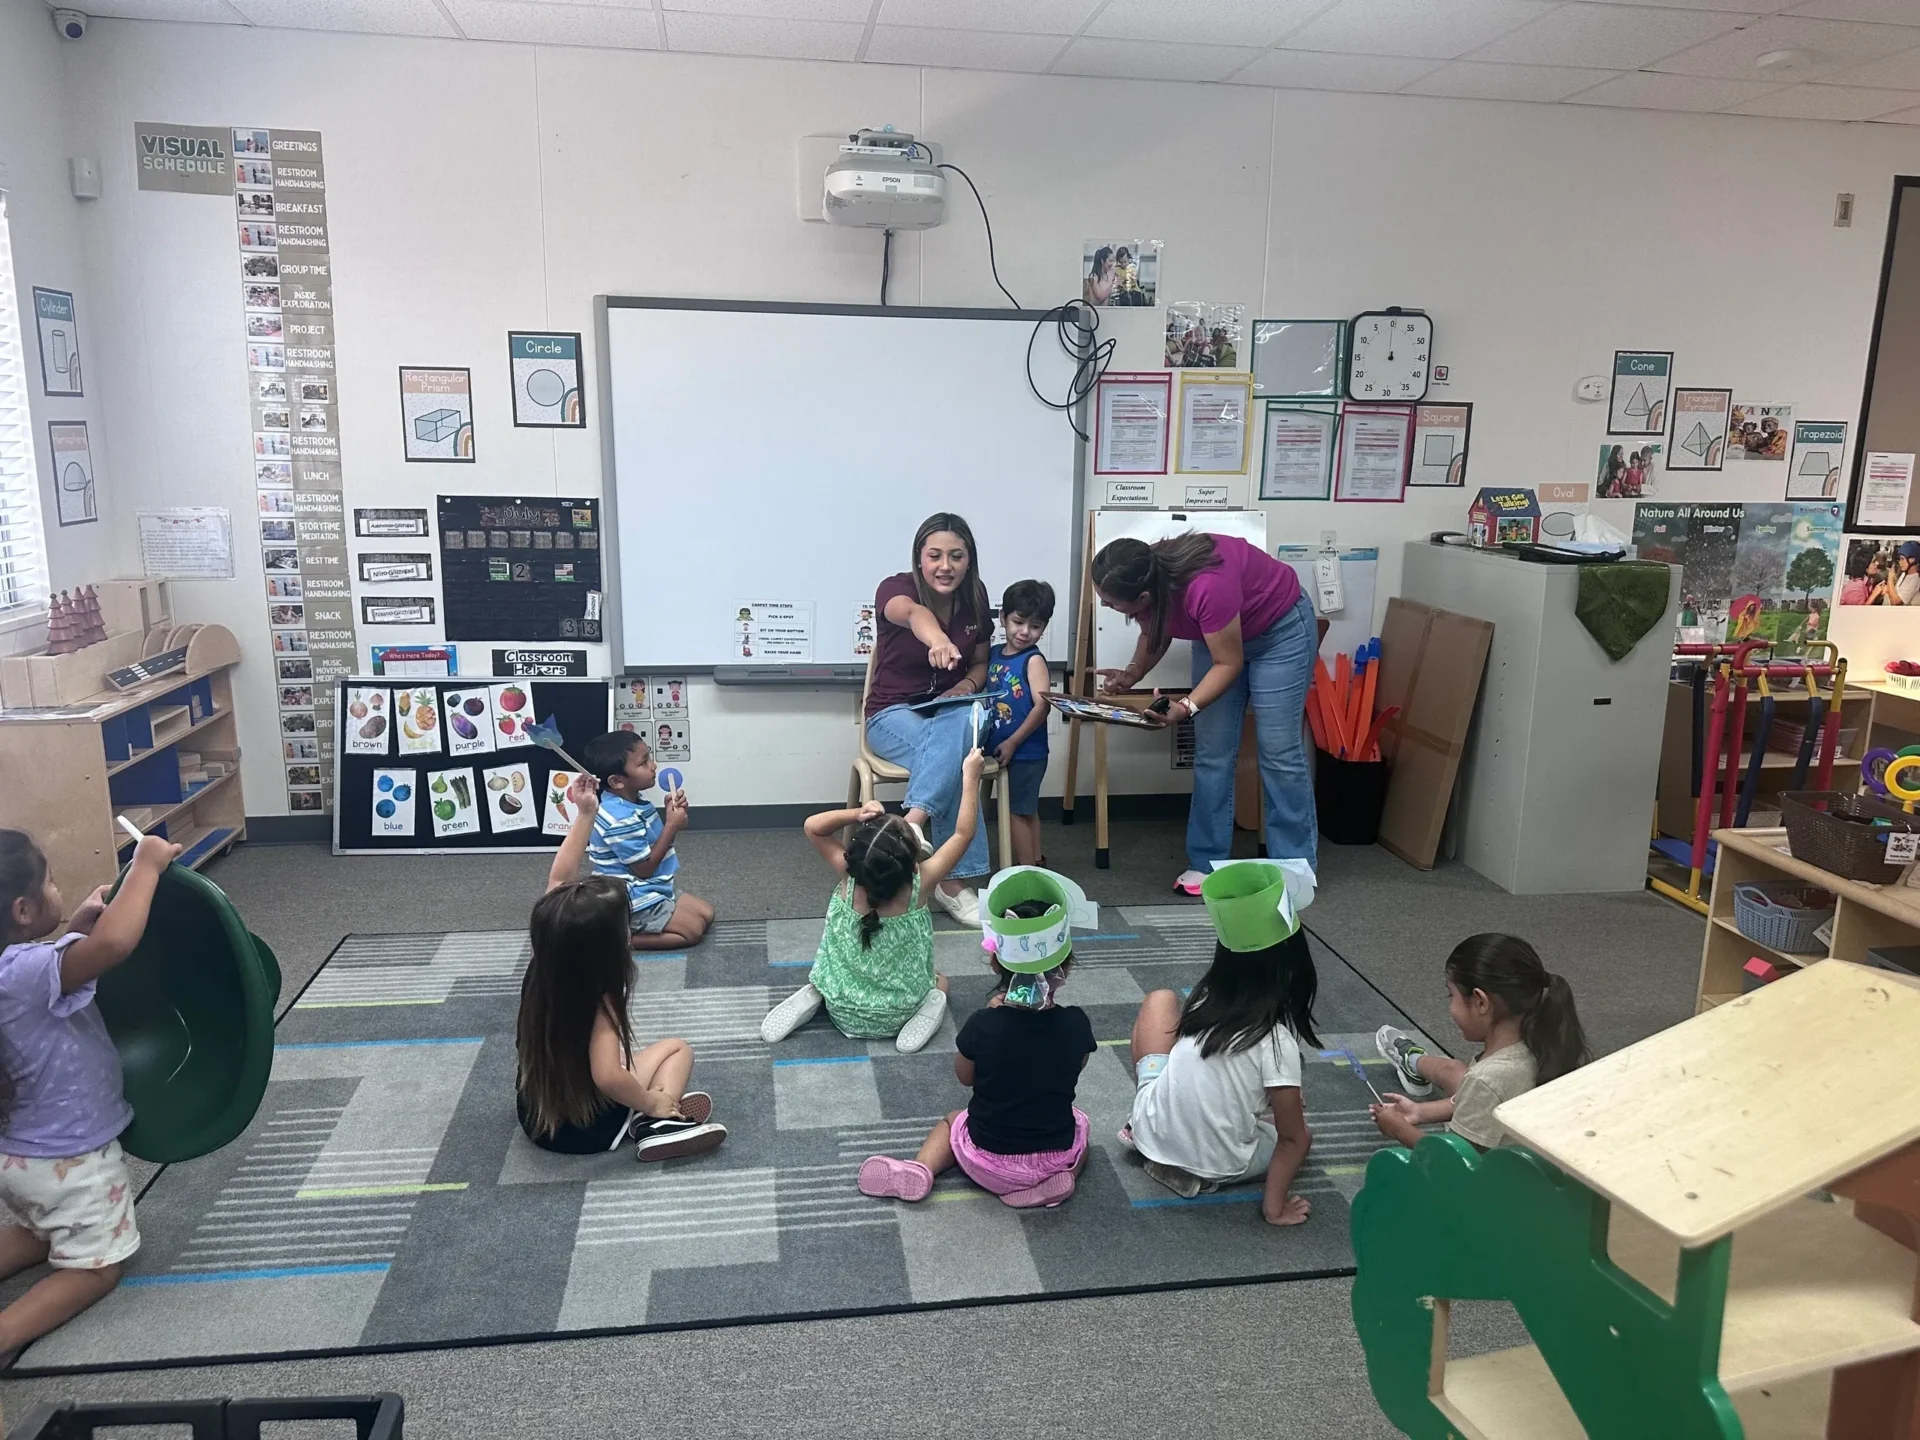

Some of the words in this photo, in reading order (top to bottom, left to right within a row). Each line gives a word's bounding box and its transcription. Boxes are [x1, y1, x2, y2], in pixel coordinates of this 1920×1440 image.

[140, 135, 225, 159] VISUAL
[272, 141, 318, 152] GREETINGS
[142, 156, 226, 174] SCHEDULE
[278, 168, 317, 177] RESTROOM
[276, 179, 324, 189] HANDWASHING
[276, 203, 324, 214] BREAKFAST
[278, 226, 323, 236] RESTROOM
[278, 238, 327, 247] HANDWASHING
[280, 264, 308, 274] GROUP
[309, 266, 328, 275] TIME
[294, 292, 316, 300] INSIDE
[40, 298, 69, 315] Cylinder
[282, 300, 331, 309] EXPLORATION
[1374, 324, 1379, 332] 5
[1406, 324, 1415, 332] 55
[1390, 320, 1395, 328] 0
[290, 325, 325, 335] PROJECT
[1360, 336, 1368, 344] 10
[526, 340, 562, 354] Circle
[286, 349, 331, 359] RESTROOM
[1354, 354, 1361, 362] 15
[1418, 354, 1426, 362] 45
[286, 360, 334, 369] HANDWASHING
[1630, 360, 1655, 371] Cone
[404, 372, 467, 384] Rectangular
[421, 382, 451, 393] Prism
[1364, 384, 1373, 392] 25
[1684, 394, 1722, 404] Triangular
[1685, 402, 1717, 412] Pyramid
[1422, 410, 1460, 425] Square
[1798, 428, 1844, 440] Trapezoid
[292, 436, 336, 446] RESTROOM
[291, 448, 339, 456] HANDWASHING
[304, 472, 329, 481] LUNCH
[296, 494, 339, 502] RESTROOM
[1554, 488, 1574, 498] Oval
[294, 504, 342, 512] HANDWASHING
[1640, 508, 1675, 518] Nature
[1678, 508, 1691, 518] All
[1693, 508, 1730, 518] Around
[1732, 508, 1745, 518] Us
[504, 506, 541, 523] July
[299, 522, 341, 531] STORYTIME
[1654, 525, 1667, 533] Fall
[1704, 525, 1725, 533] Winter
[1756, 525, 1777, 535] Spring
[302, 532, 339, 540] MEDITATION
[516, 564, 526, 578] 2
[306, 580, 344, 588] RESTROOM
[304, 590, 351, 598] HANDWASHING
[315, 612, 342, 620] SNACK
[566, 620, 575, 633] 3
[582, 621, 596, 635] 13
[310, 631, 352, 640] RESTROOM
[506, 651, 573, 662] Classroom
[316, 666, 352, 674] MOVEMENT
[508, 734, 526, 742] red
[352, 740, 383, 749] brown
[455, 740, 485, 751] purple
[384, 822, 403, 830] blue
[442, 821, 469, 832] green
[548, 822, 571, 830] oran
